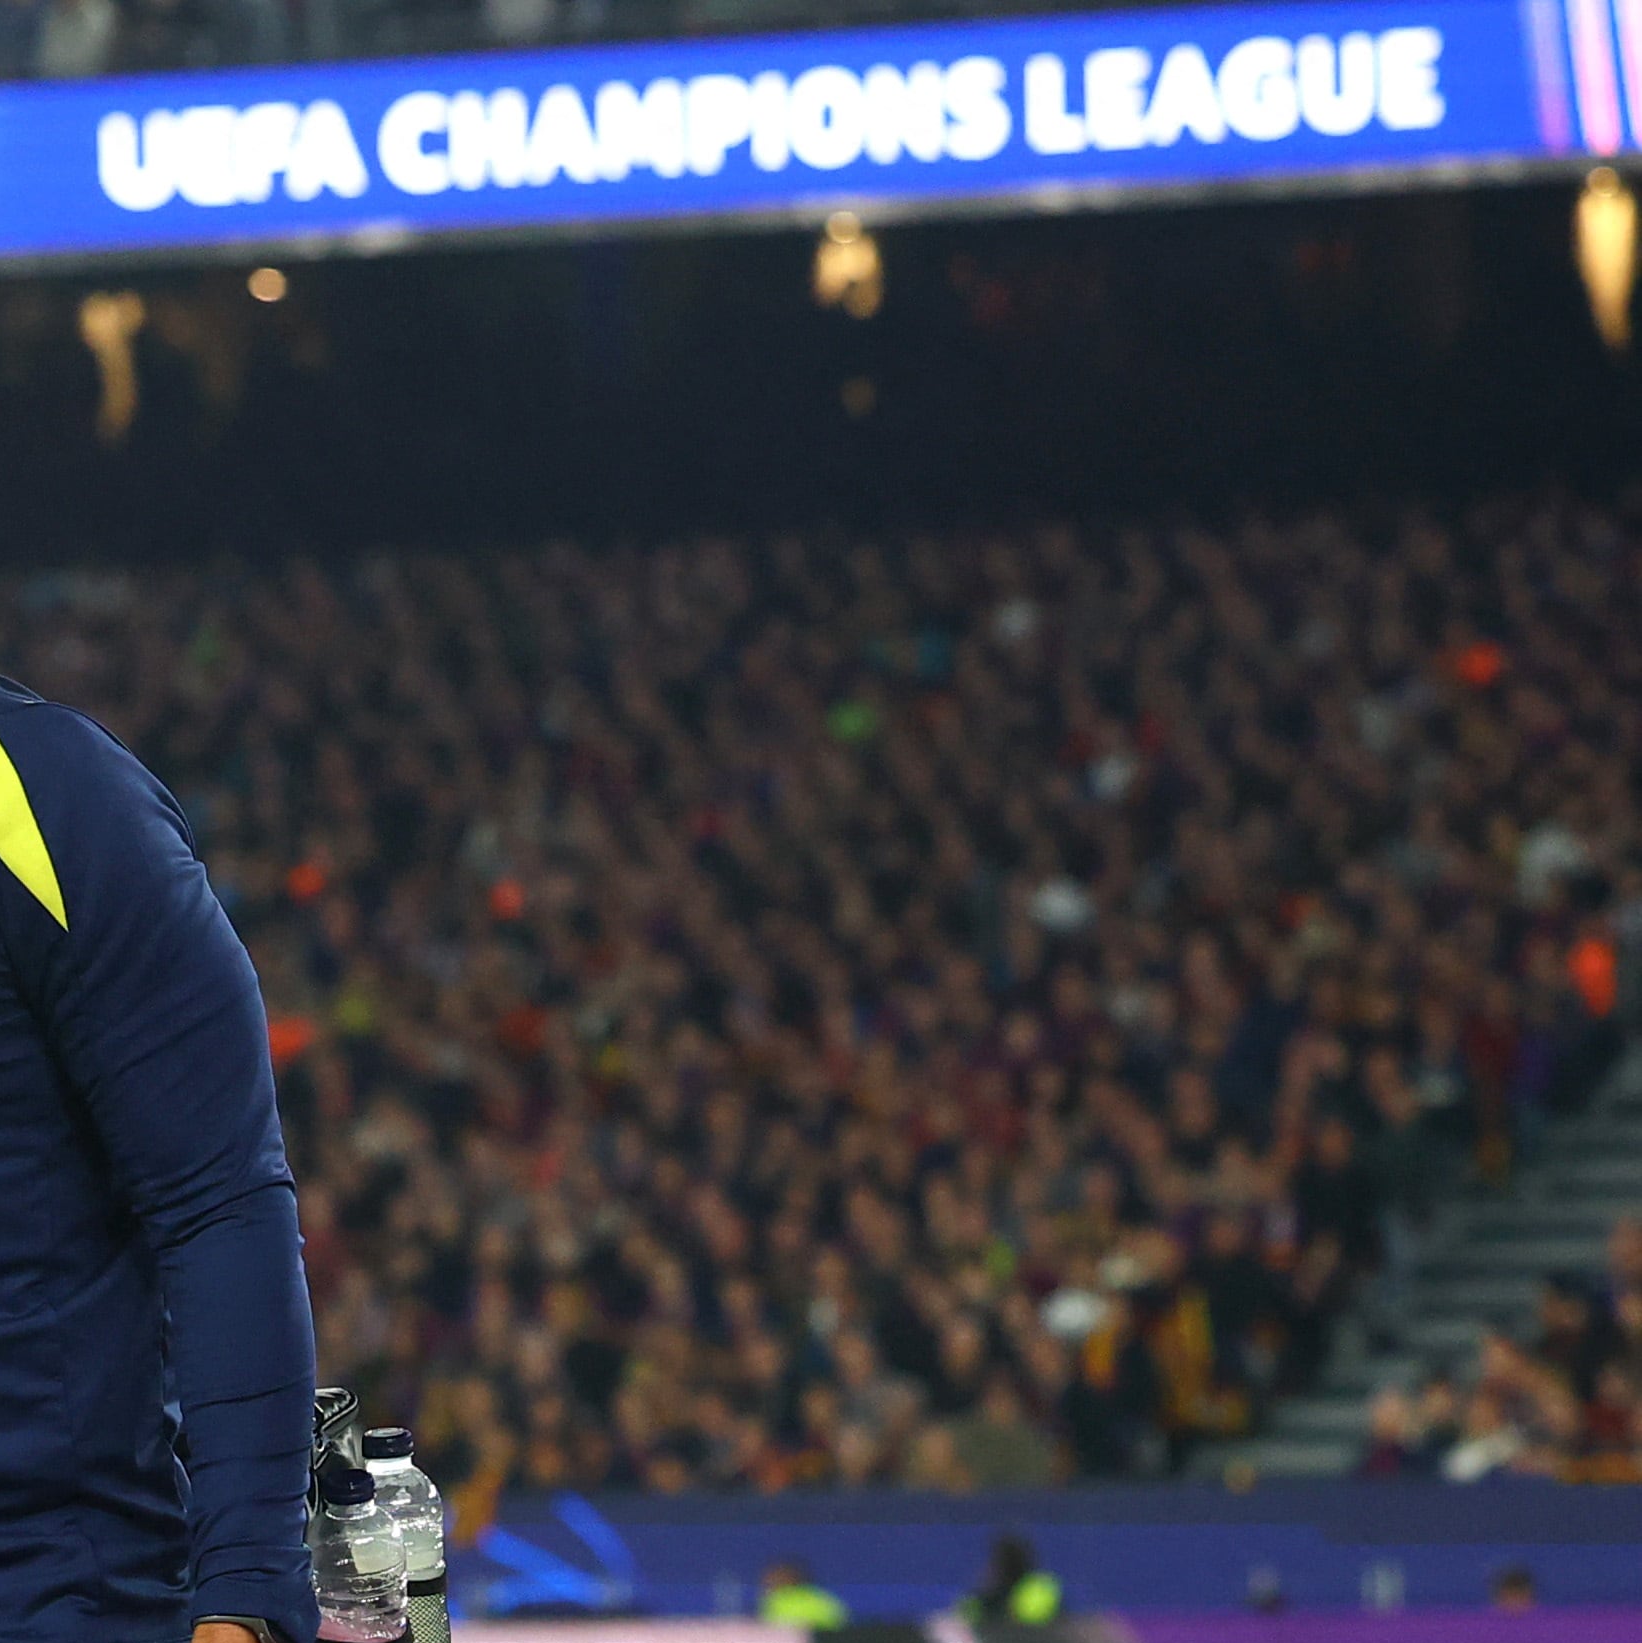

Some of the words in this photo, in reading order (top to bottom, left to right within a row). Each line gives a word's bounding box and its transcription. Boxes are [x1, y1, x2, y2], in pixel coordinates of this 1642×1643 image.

[97, 99, 369, 211] UEFA
[377, 55, 1010, 195] CHAMPIONS
[1024, 26, 1445, 155] LEAGUE
